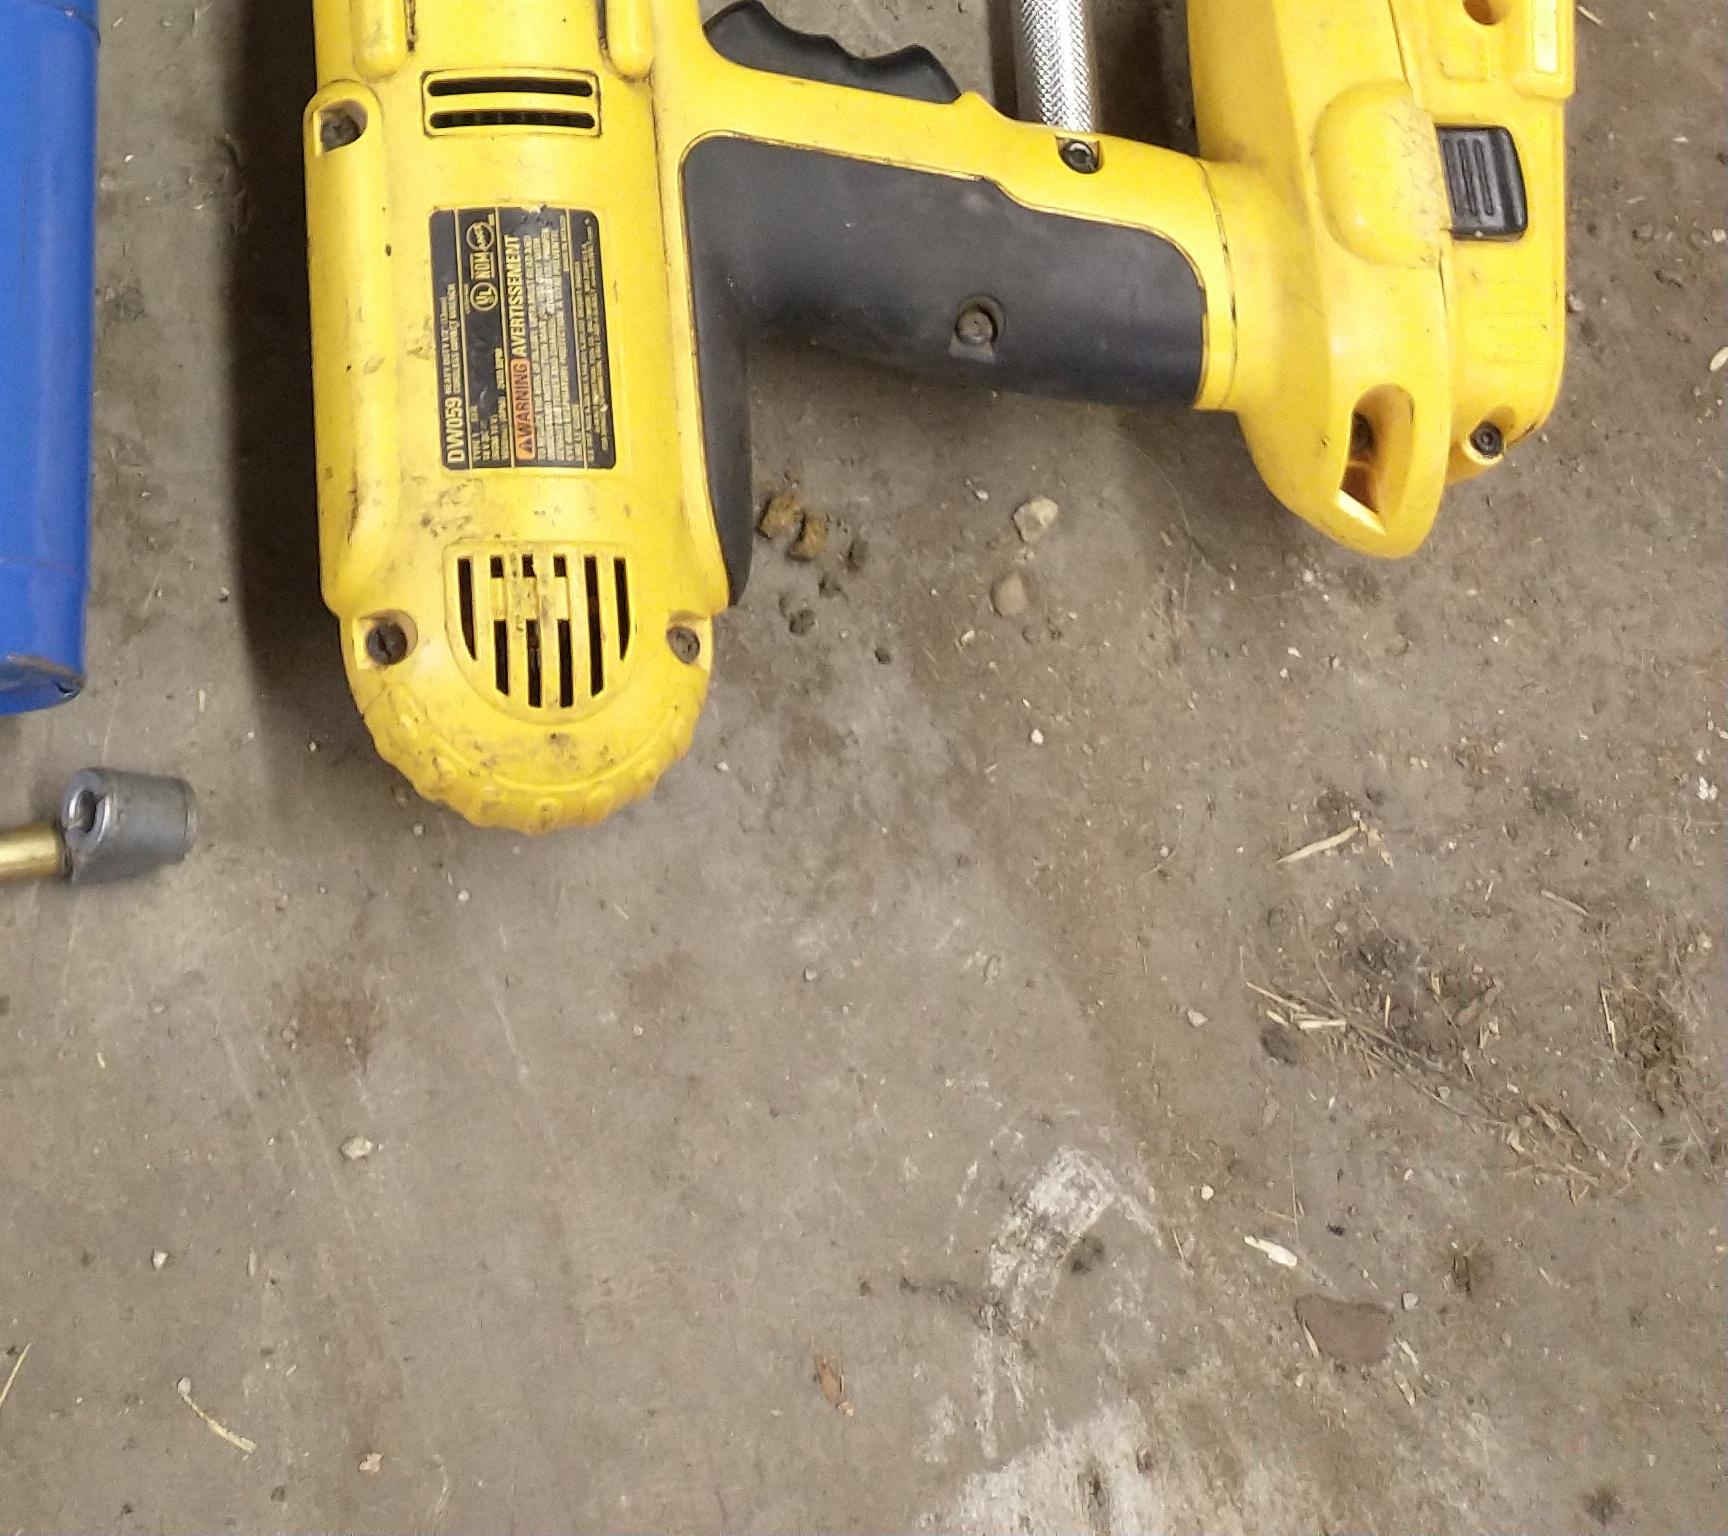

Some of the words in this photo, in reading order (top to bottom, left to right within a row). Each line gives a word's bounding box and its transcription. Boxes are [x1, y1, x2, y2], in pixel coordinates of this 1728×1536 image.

[473, 251, 492, 279] NOM
[504, 234, 528, 358] AVERTISSEMENT
[444, 396, 465, 462] DW059
[512, 362, 530, 438] WARNING
